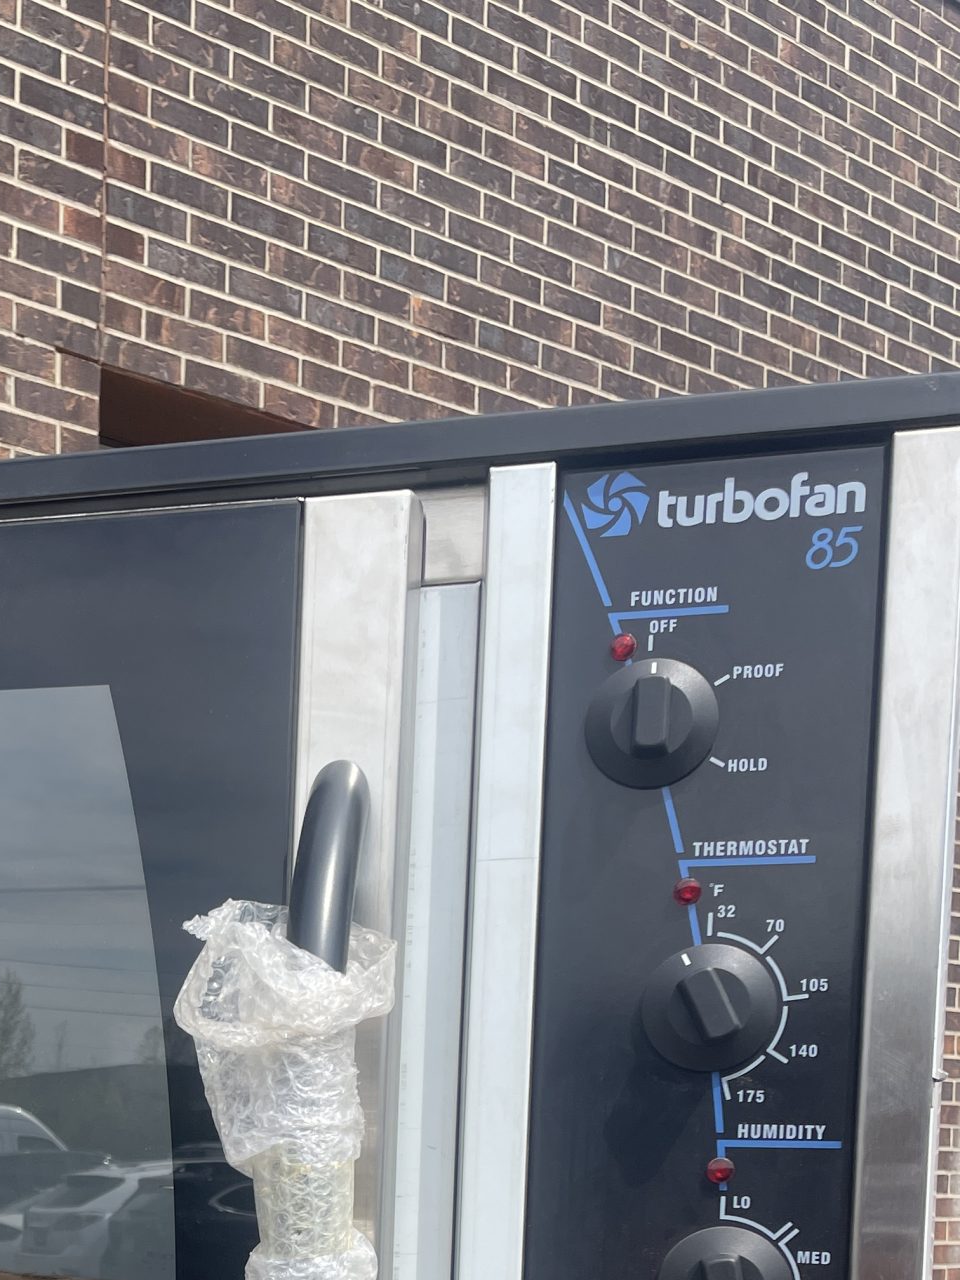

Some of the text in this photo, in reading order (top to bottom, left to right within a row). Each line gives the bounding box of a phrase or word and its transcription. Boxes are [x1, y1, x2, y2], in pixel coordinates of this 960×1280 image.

[657, 471, 866, 528] turbofan
[805, 525, 863, 570] 85
[630, 586, 718, 607] FUNCTION
[649, 619, 678, 634] OFF
[733, 663, 784, 679] PROOF
[727, 757, 768, 772] HOLD
[693, 838, 809, 857] THERMOSTAT
[717, 905, 736, 918] 32
[766, 919, 785, 933] 70
[799, 978, 829, 992] 105
[790, 1044, 818, 1058] 140
[736, 1090, 765, 1103] 175
[737, 1123, 826, 1140] HUMIDITY
[733, 1196, 751, 1209] LO
[797, 1251, 831, 1265] MED
